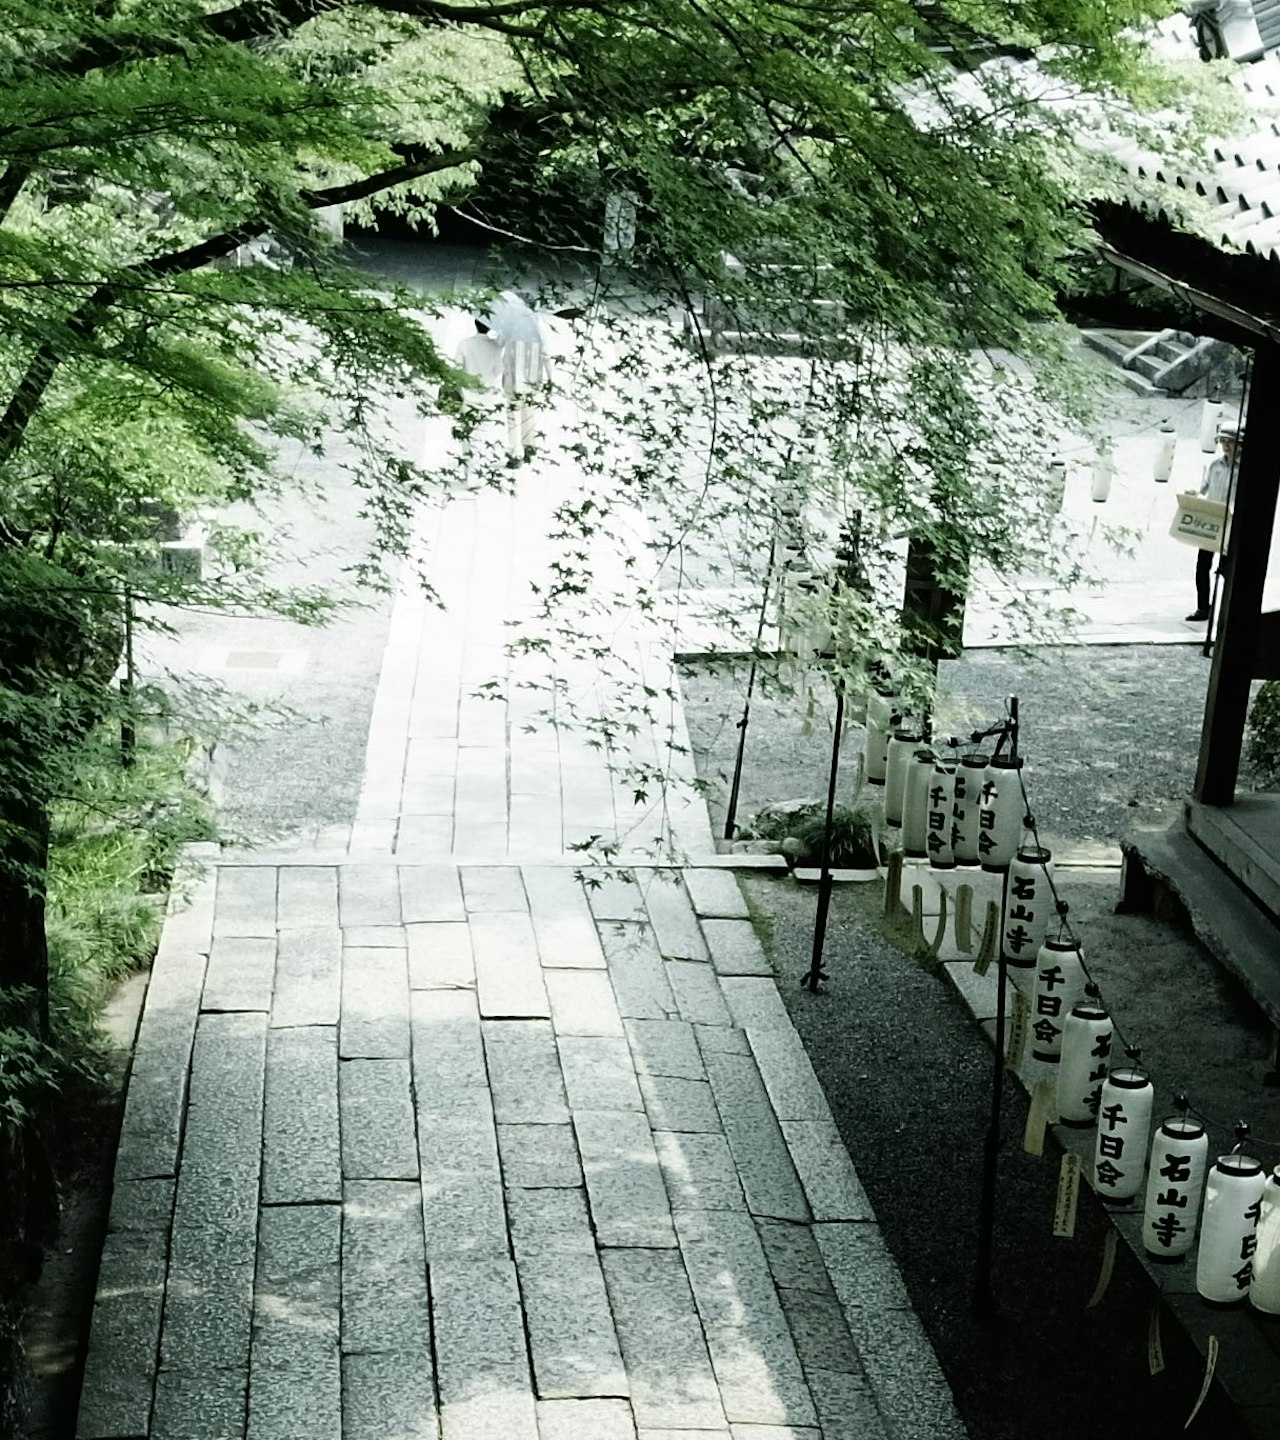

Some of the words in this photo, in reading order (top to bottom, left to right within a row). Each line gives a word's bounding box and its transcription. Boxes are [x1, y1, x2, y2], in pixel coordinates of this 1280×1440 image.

[928, 786, 947, 854] 千日会
[1006, 876, 1035, 954] 石山寺
[1033, 965, 1065, 1044] 千日会
[1096, 1103, 1127, 1187] 千日会
[1152, 1153, 1191, 1247] 石山寺
